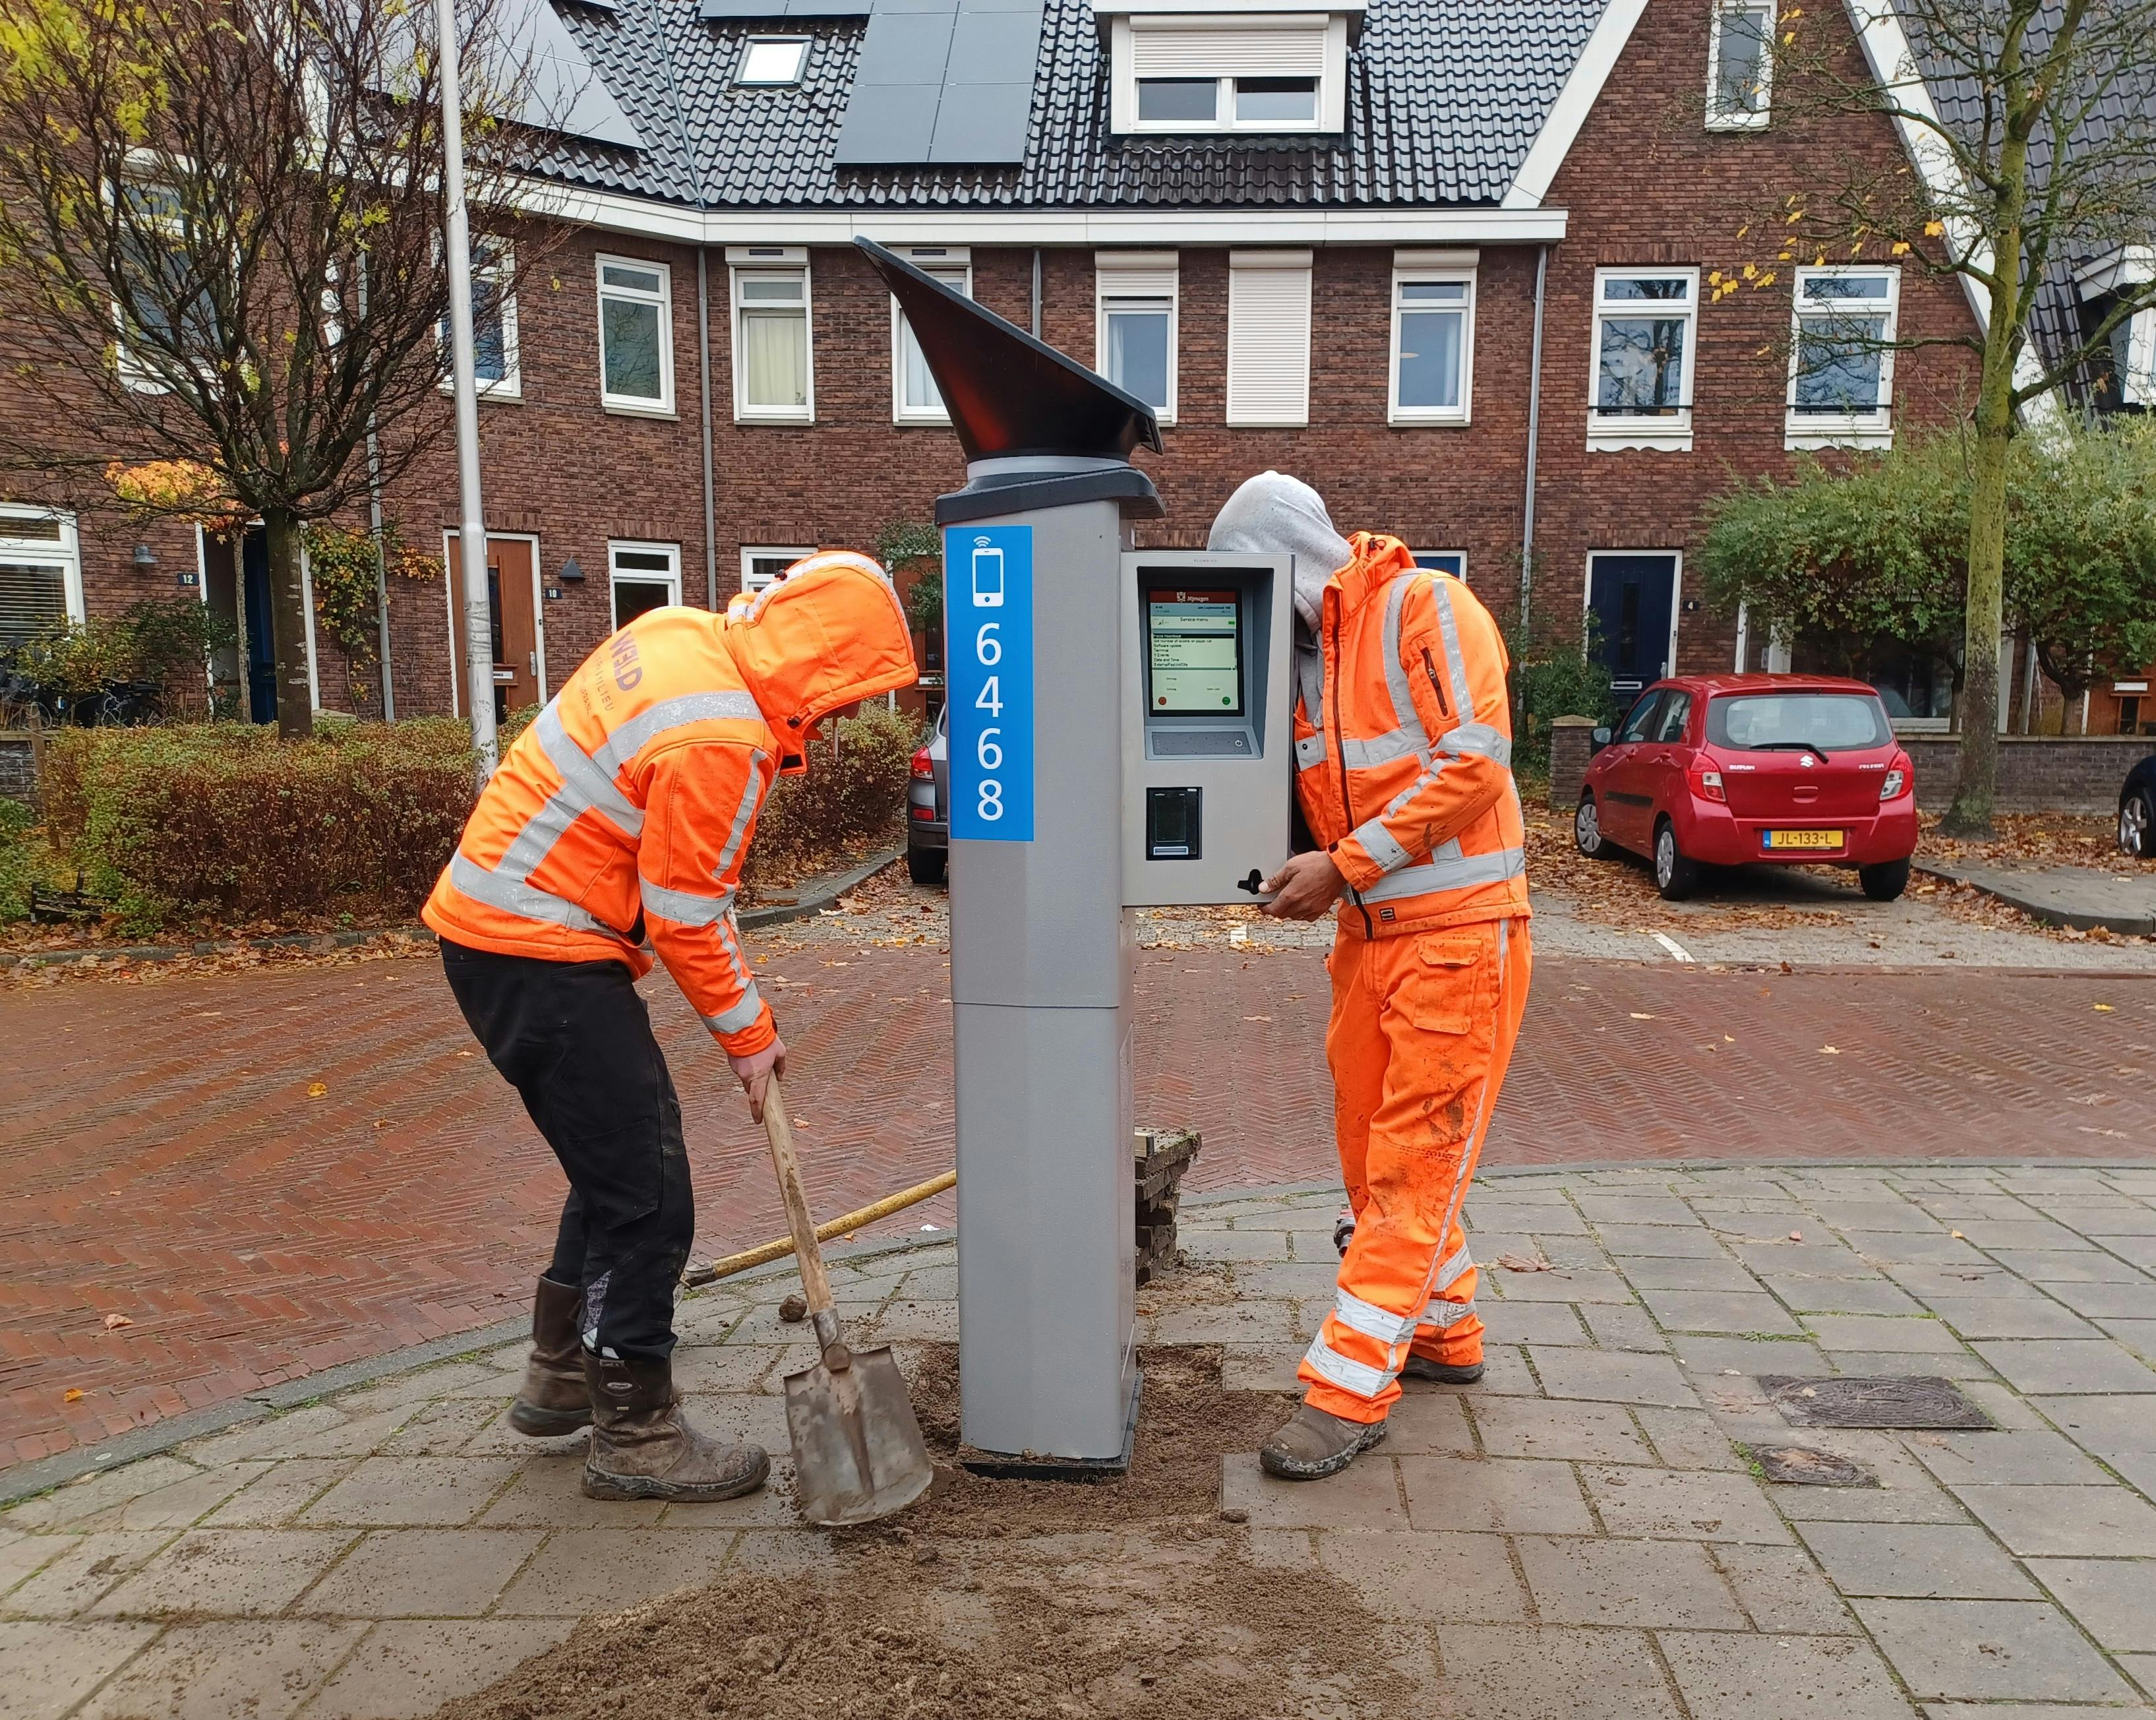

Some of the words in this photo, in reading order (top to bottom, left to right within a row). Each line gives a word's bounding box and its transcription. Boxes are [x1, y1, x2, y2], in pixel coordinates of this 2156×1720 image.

[183, 574, 193, 584] 12
[549, 589, 557, 598] 10
[1778, 832, 1832, 844] JL-133-L
